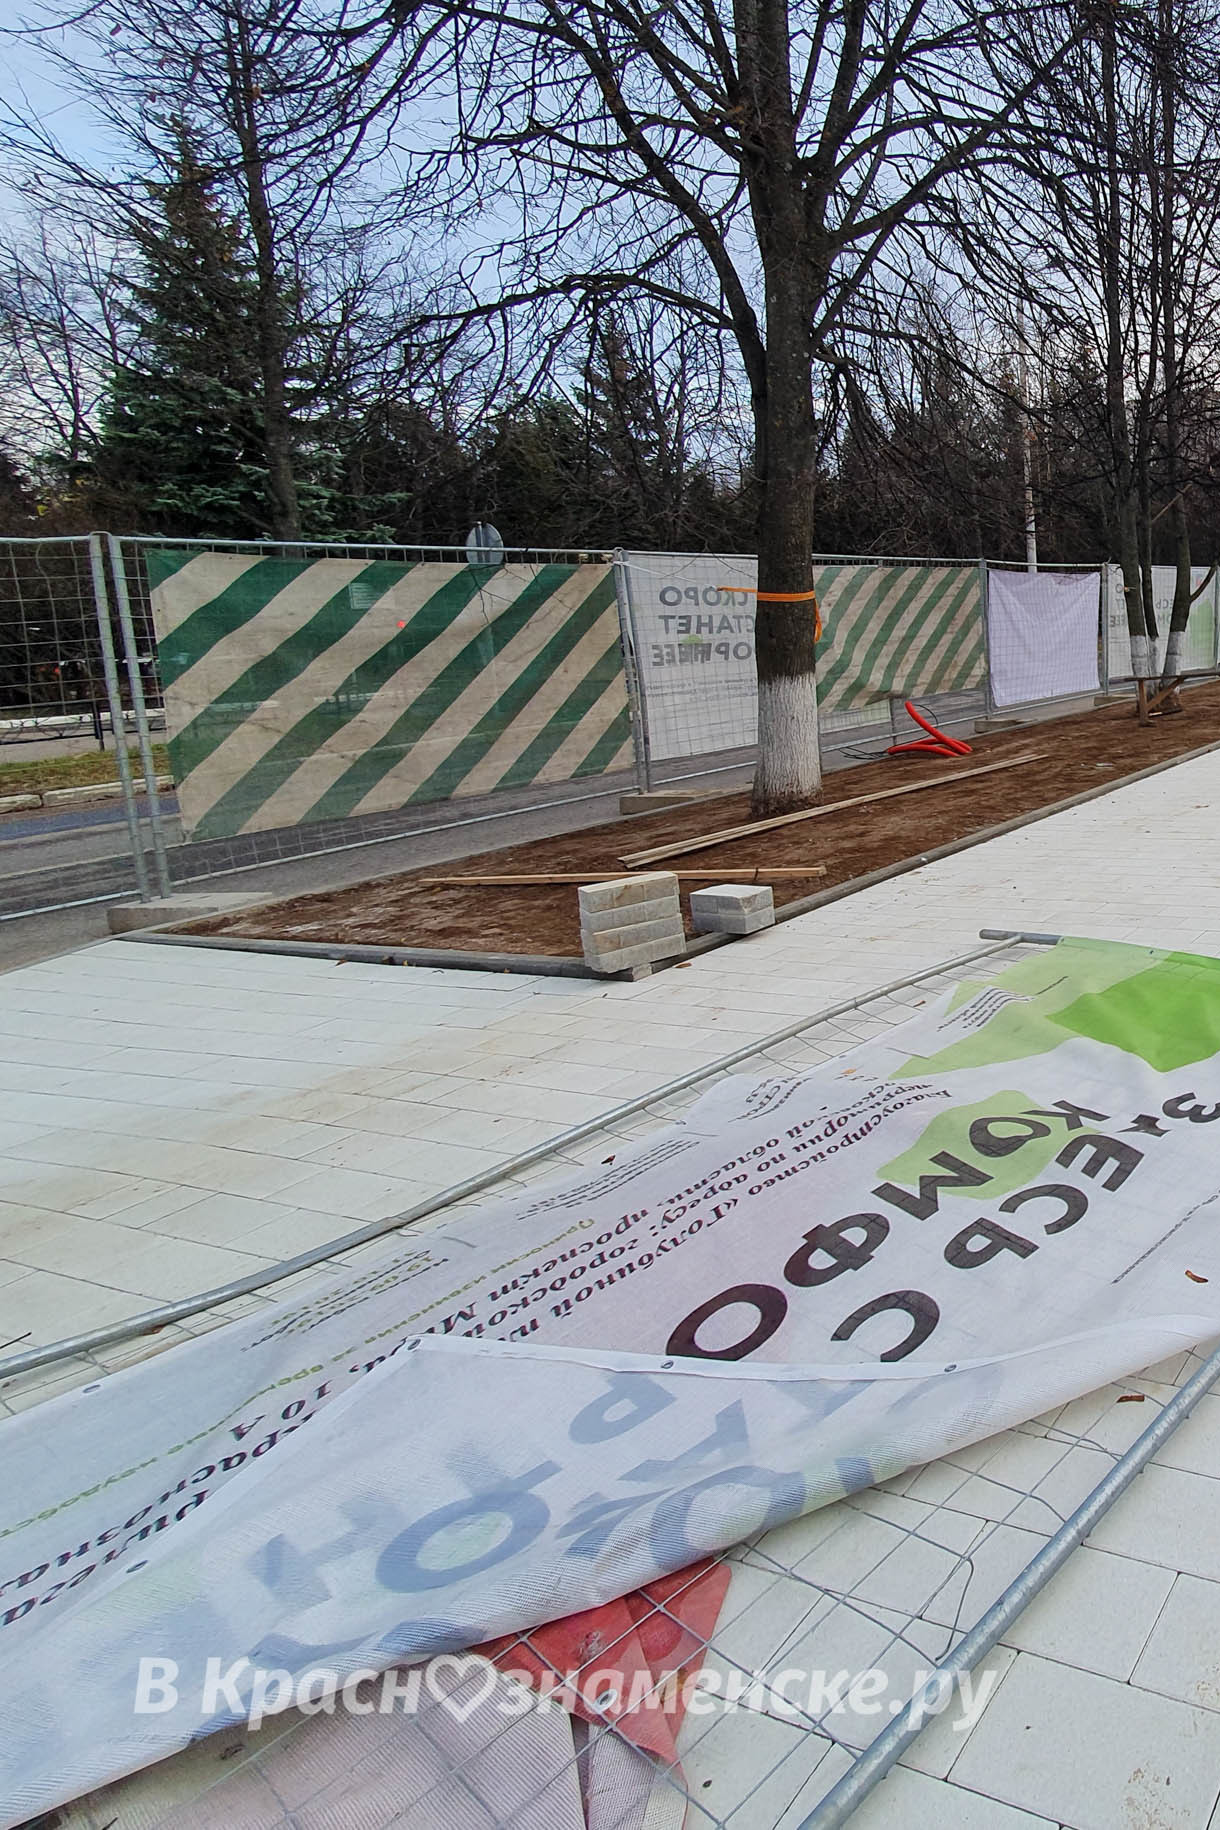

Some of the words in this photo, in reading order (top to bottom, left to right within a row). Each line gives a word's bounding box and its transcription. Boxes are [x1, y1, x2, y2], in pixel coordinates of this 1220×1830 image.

[756, 1151, 782, 1174] по
[647, 1172, 745, 1235] адресу:
[487, 1208, 649, 1303] проспект
[550, 1202, 739, 1319] «Голубиной
[230, 1414, 264, 1440] А
[279, 1379, 331, 1421] 10
[0, 1457, 158, 1538] неудобст
[0, 1488, 206, 1627] рилега
